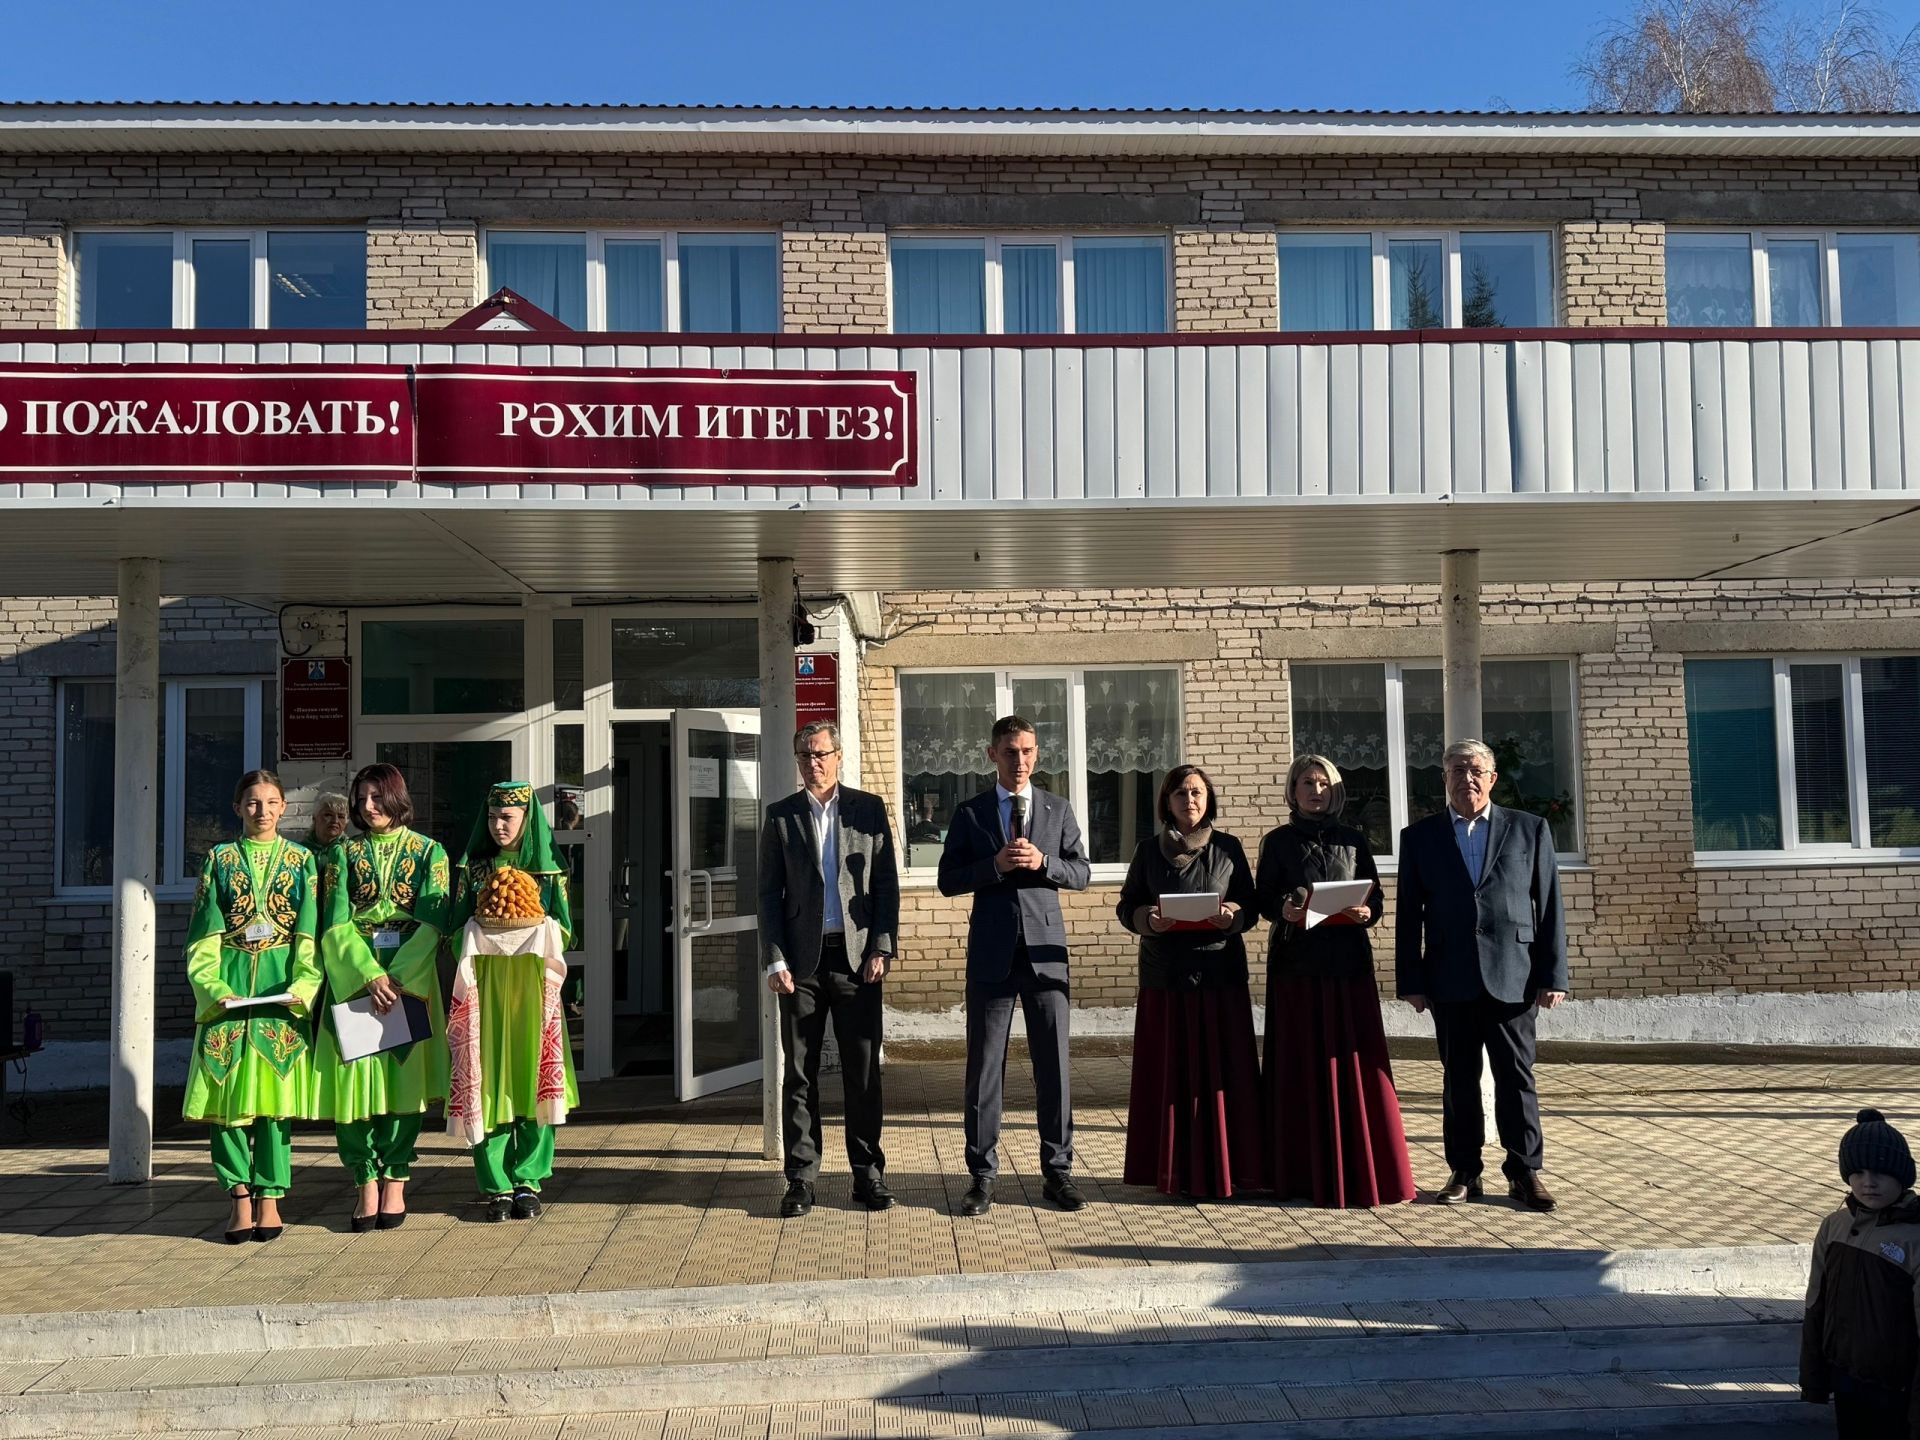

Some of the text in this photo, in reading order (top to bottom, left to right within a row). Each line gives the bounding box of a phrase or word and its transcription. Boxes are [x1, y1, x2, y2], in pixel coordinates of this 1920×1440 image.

[21, 399, 400, 436] ПОЖАЛОВАТЬ!
[497, 401, 895, 442] РӘХИМ ИТЕГЕЗ!
